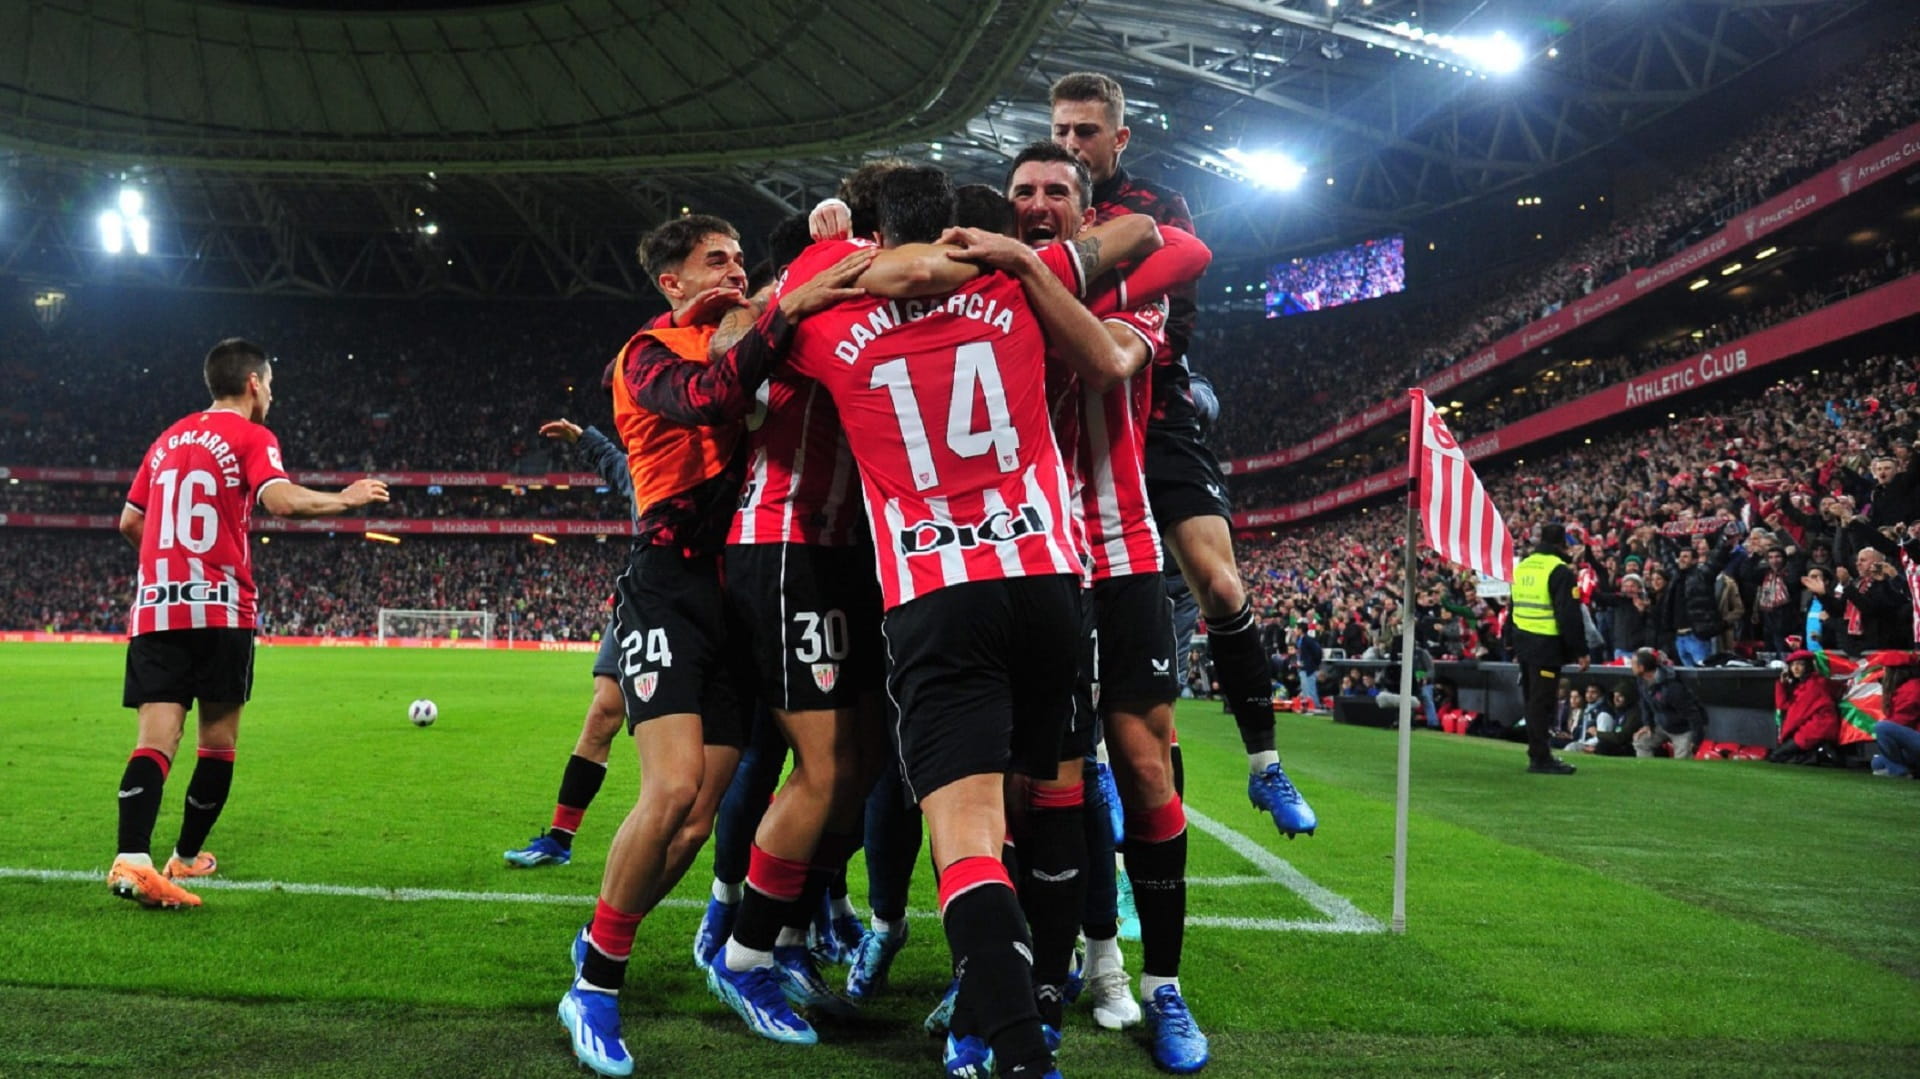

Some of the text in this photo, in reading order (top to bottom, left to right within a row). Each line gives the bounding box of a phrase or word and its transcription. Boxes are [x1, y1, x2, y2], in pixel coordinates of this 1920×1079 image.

[1858, 152, 1901, 180] ATHLETIC
[1759, 194, 1816, 227] ATHLETIC CLUB
[834, 293, 1014, 365] DANI GARCIA
[1625, 348, 1748, 408] ATHLETIC CLUB
[870, 341, 1020, 492] 14
[168, 430, 240, 488] GALARRETA
[430, 475, 487, 485] kutxabank
[155, 468, 219, 554] 16
[432, 522, 490, 533] kutxabank
[499, 522, 557, 533] kutxabank
[567, 523, 625, 534] kutxabank
[901, 504, 1047, 556] DIGI
[140, 582, 229, 606] DIGI
[621, 627, 673, 676] 24
[794, 609, 849, 664] 30
